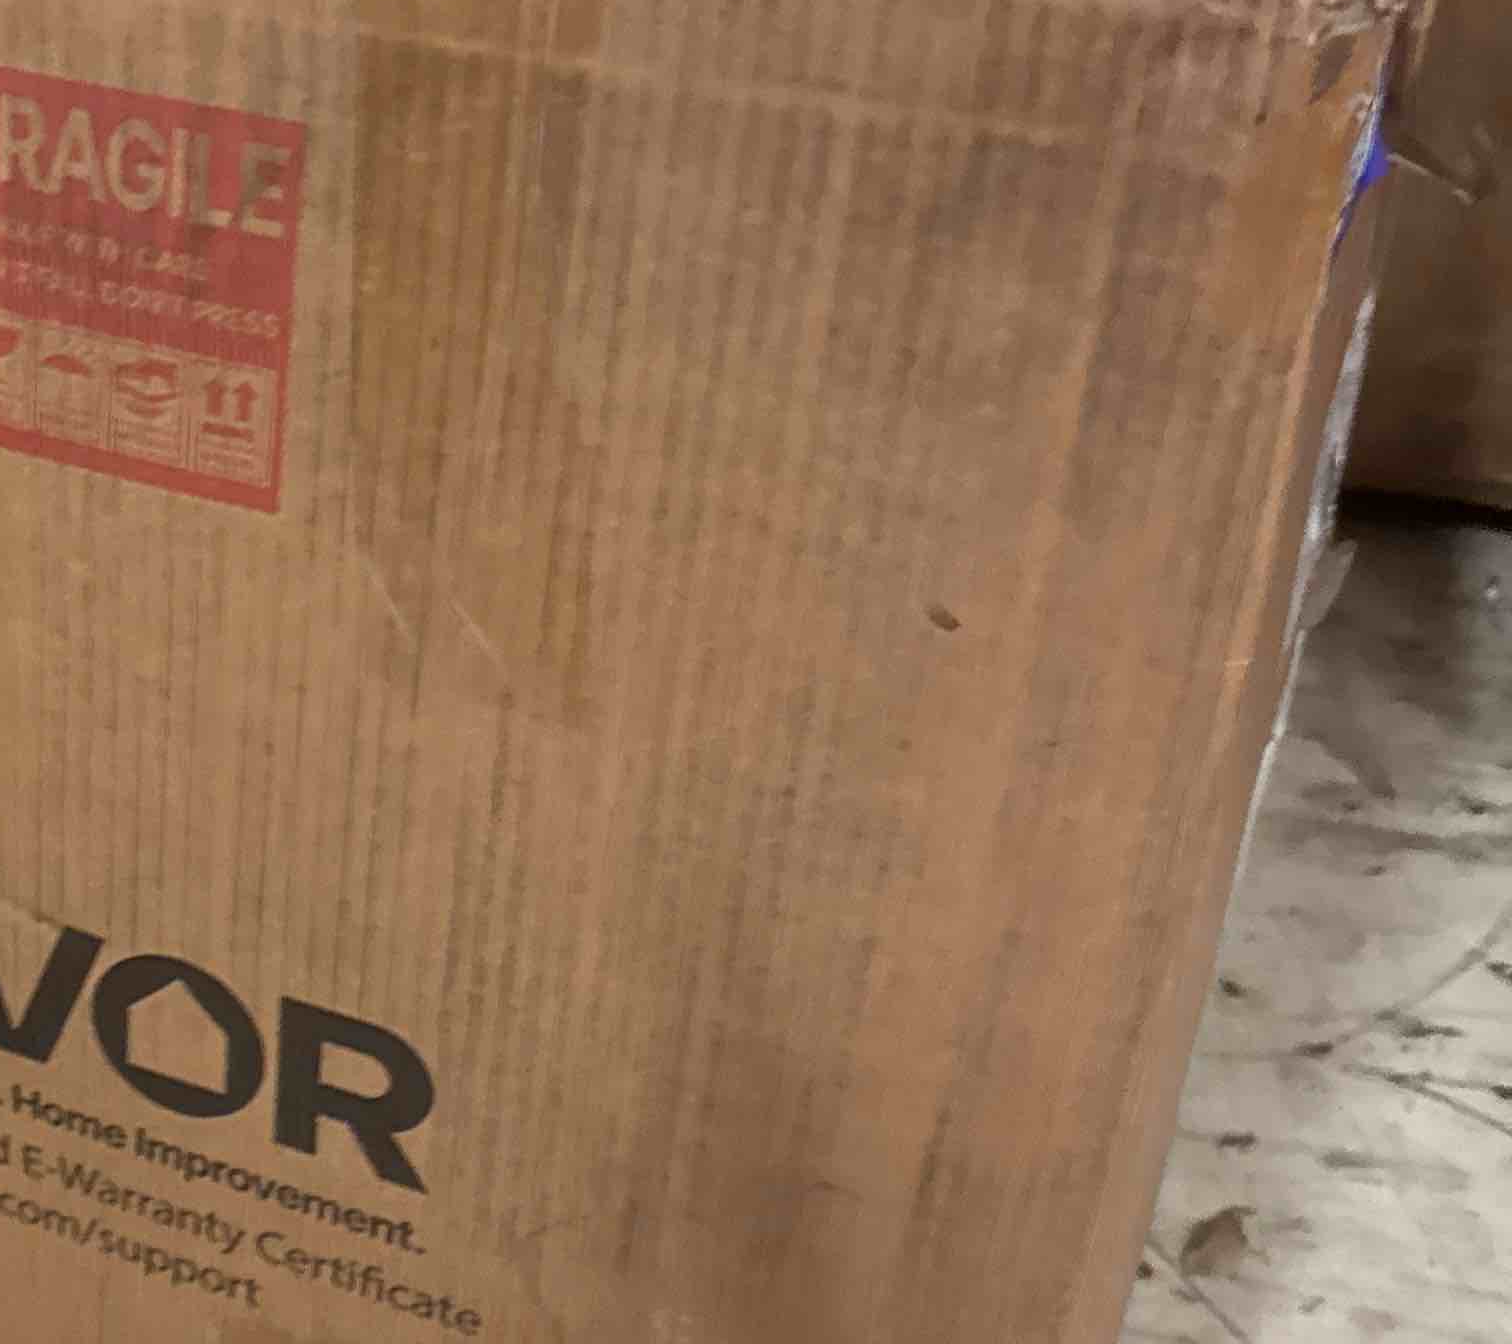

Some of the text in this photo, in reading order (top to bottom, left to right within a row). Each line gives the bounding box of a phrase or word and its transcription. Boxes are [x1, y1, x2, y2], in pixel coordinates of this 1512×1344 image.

[10, 1083, 128, 1150] Home
[133, 1125, 427, 1256] Improvement.
[21, 1143, 247, 1255] E-Warranty
[254, 1230, 484, 1337] Certificate
